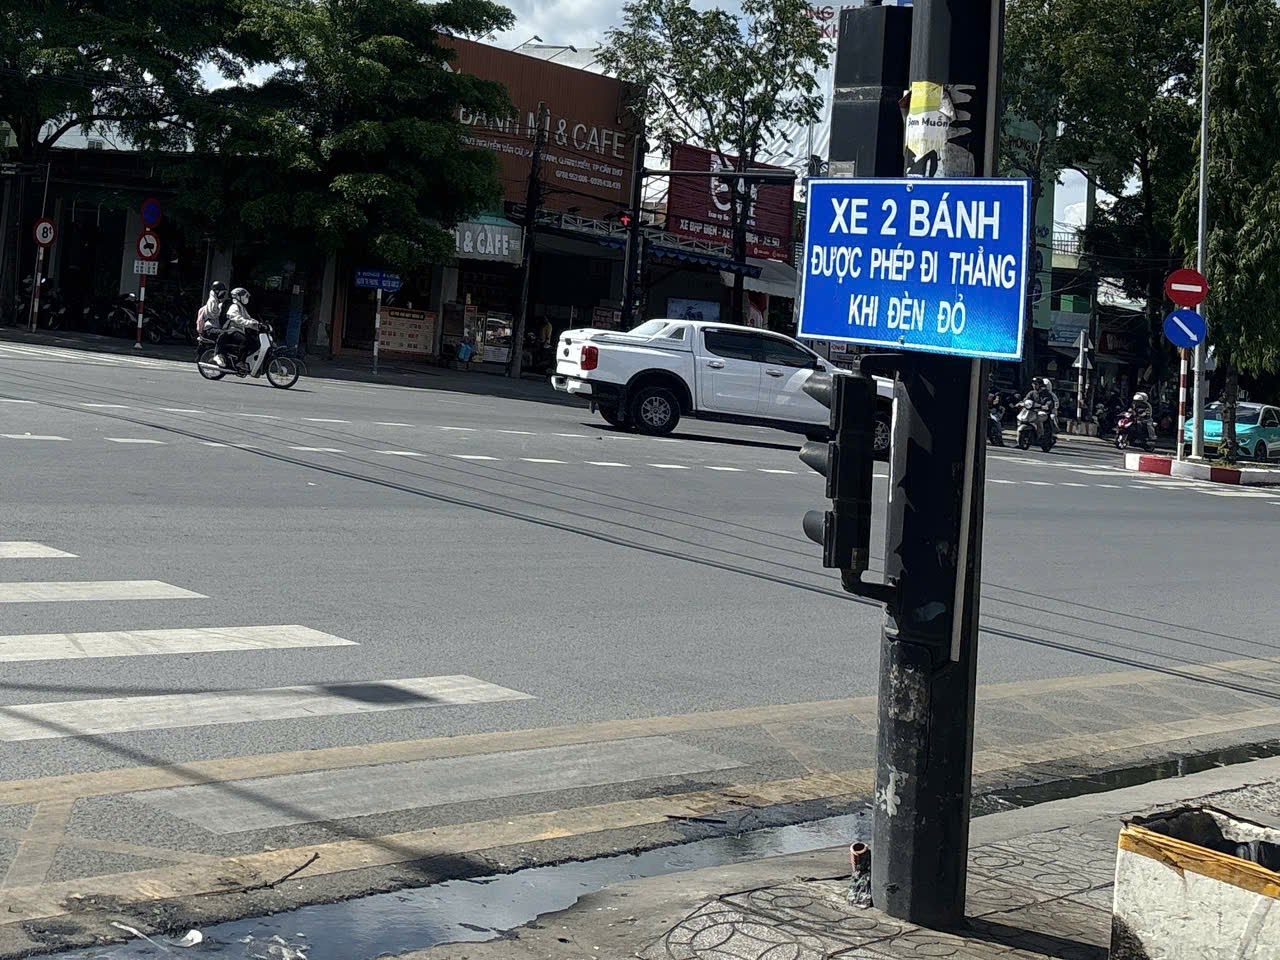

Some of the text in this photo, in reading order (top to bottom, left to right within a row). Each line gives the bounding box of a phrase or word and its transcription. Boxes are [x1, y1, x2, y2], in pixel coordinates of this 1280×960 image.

[555, 118, 569, 147] &
[572, 123, 627, 159] CAFE
[922, 115, 949, 127] Muốn
[828, 192, 1001, 240] XE 2 BÁNH
[463, 230, 474, 253] &
[476, 232, 509, 256] CAFE
[810, 242, 1016, 289] ĐƯỢC PHÉP ĐI THẲNG
[847, 291, 967, 335] KHI ĐÈN ĐỎ
